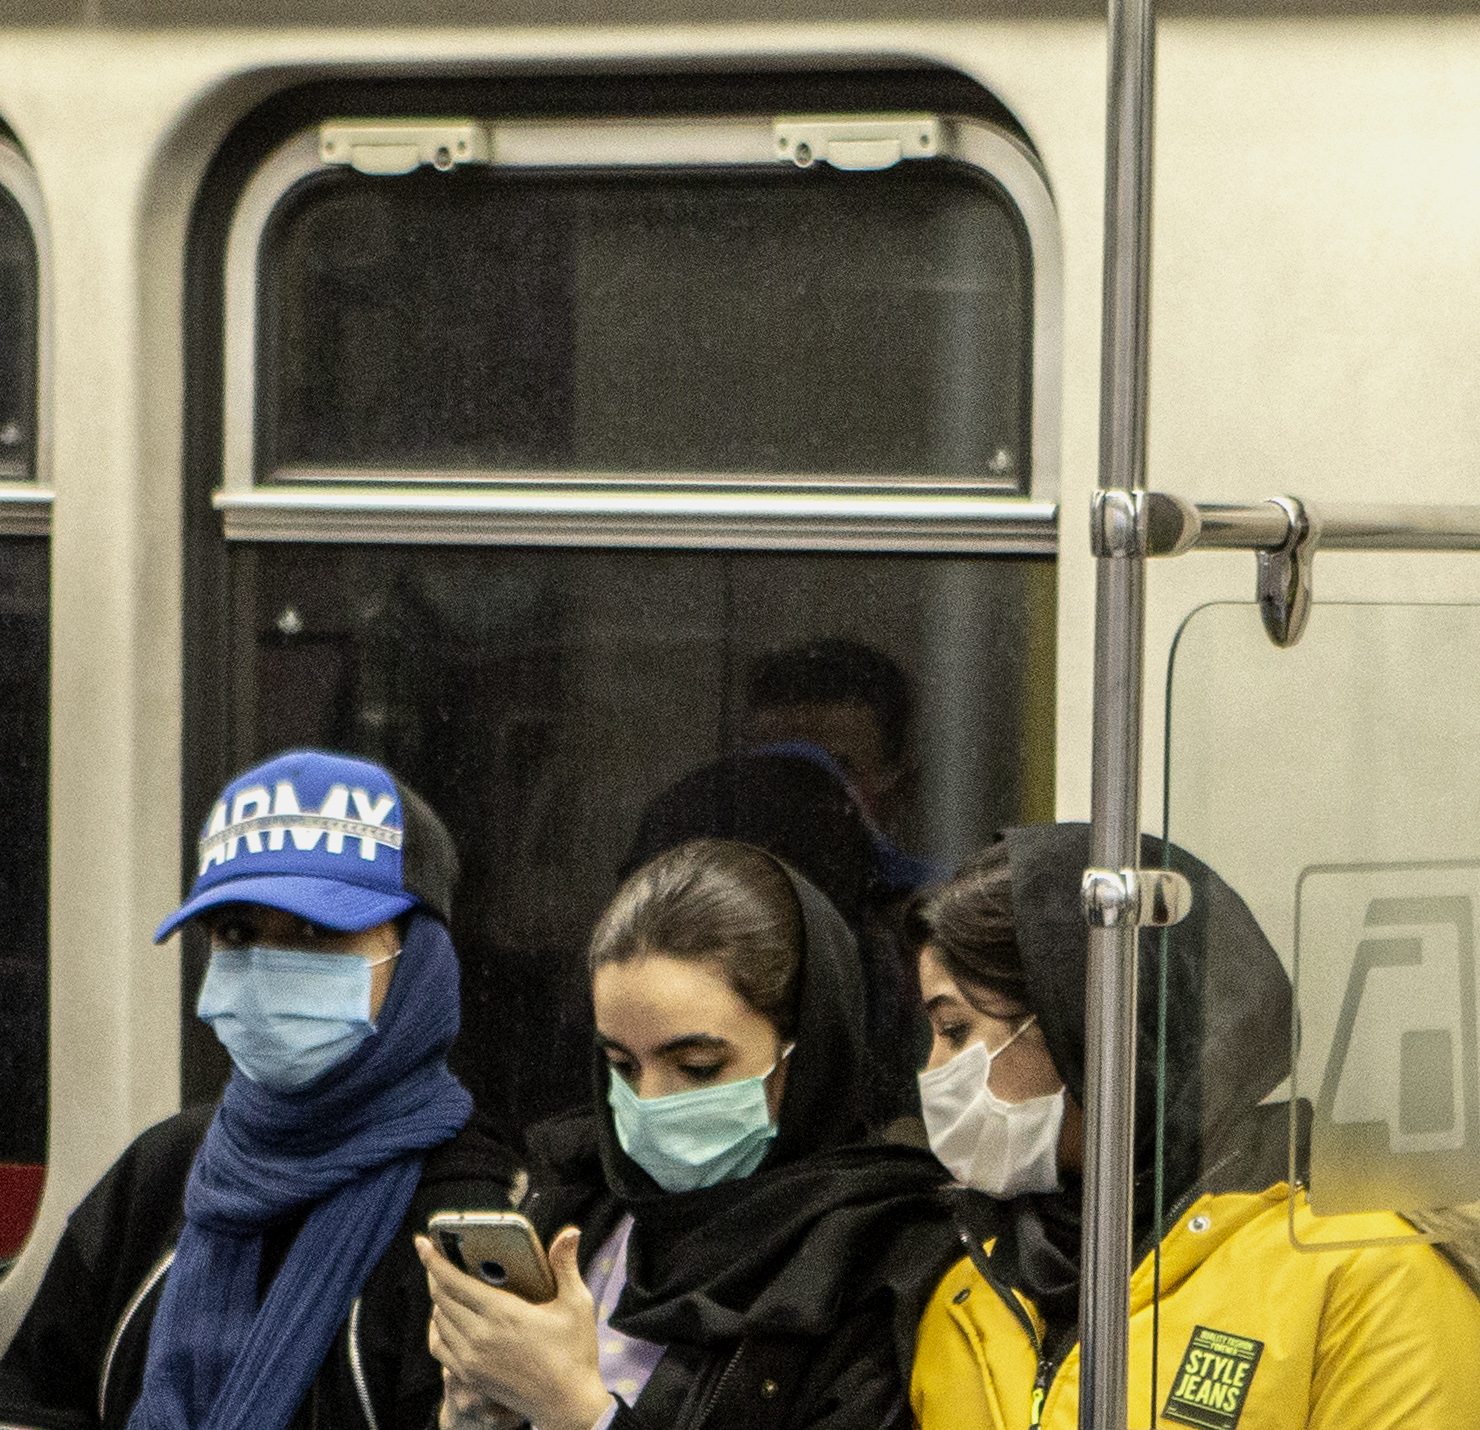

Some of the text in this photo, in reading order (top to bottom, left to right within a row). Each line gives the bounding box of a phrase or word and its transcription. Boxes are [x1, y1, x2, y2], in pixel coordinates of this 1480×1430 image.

[199, 783, 396, 876] ARMY
[1185, 1349, 1250, 1387] STYLE
[1175, 1373, 1240, 1412] JEANS
